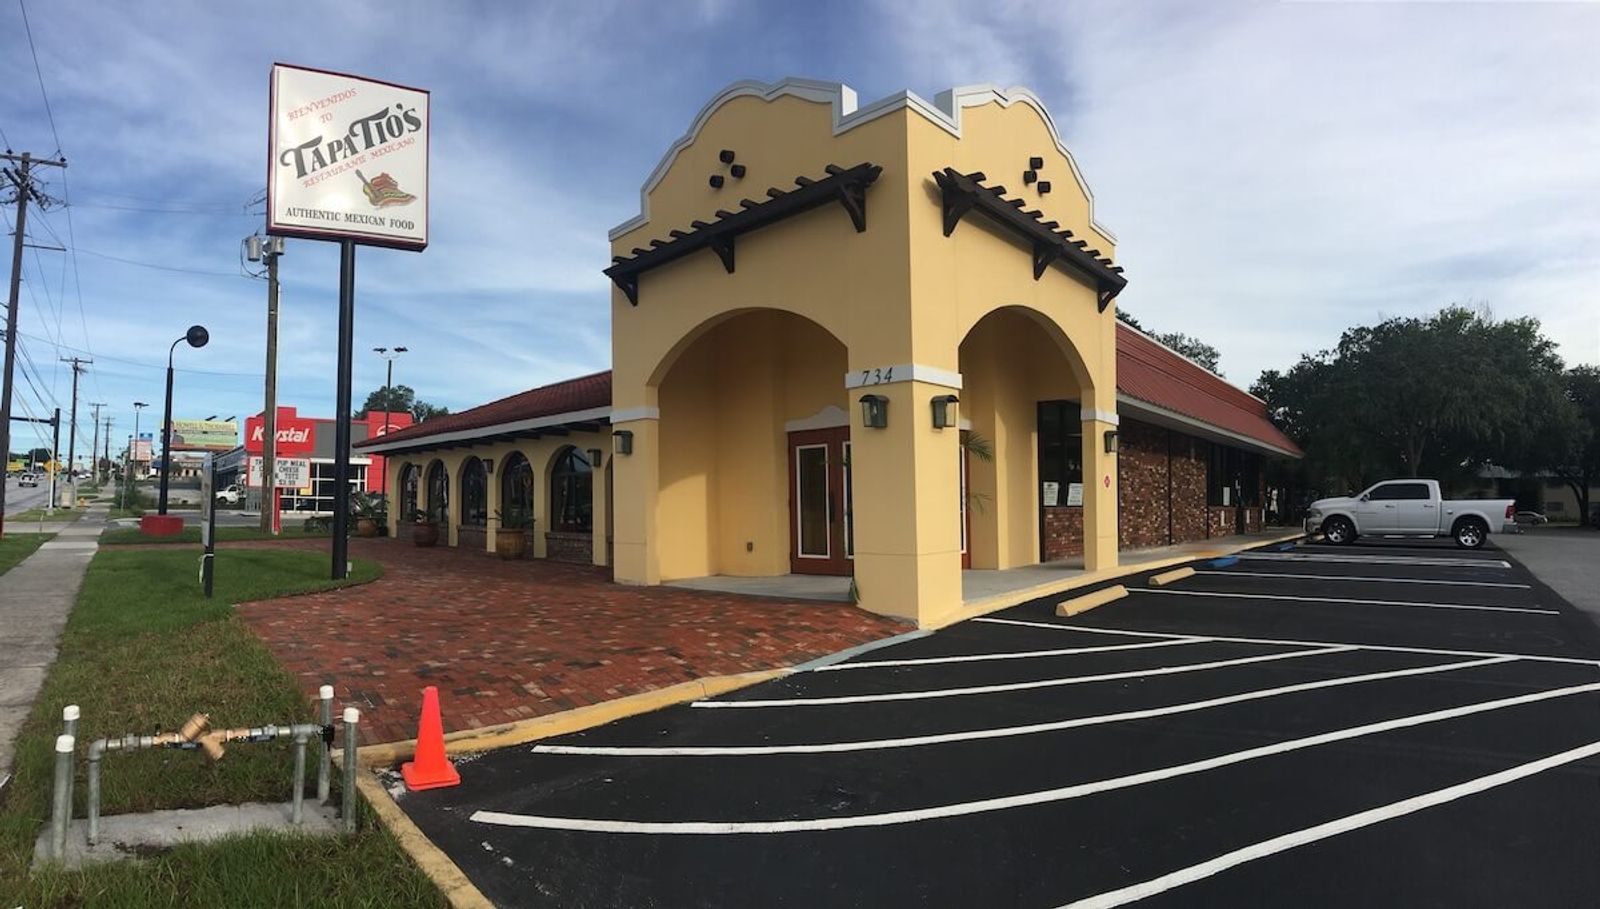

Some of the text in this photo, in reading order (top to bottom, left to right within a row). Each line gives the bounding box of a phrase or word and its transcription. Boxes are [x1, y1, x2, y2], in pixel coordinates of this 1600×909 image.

[287, 88, 358, 122] BIENVENIDOS
[320, 112, 333, 124] TO
[303, 137, 415, 188] RESTAURANTE MEXICANO
[285, 207, 415, 231] AUTHENTIC MEXICAN FOOD
[862, 367, 893, 385] 734
